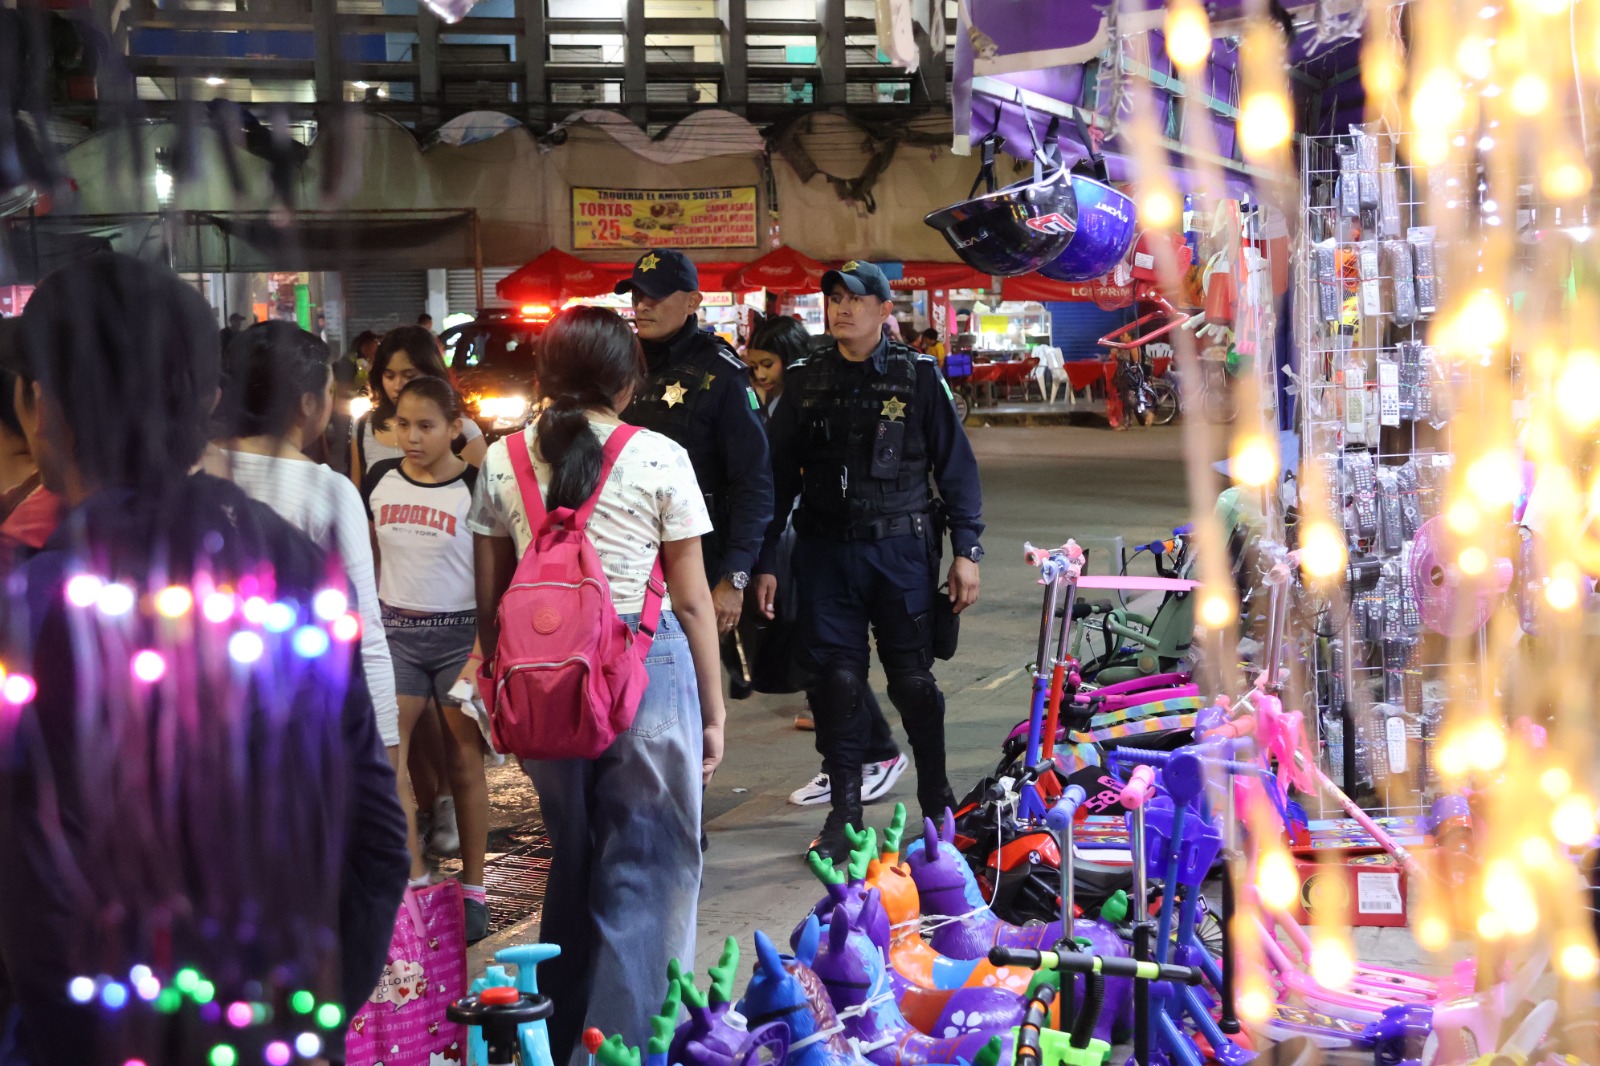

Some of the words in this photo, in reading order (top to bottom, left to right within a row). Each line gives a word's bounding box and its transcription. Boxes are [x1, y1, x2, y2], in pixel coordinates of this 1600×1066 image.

[579, 202, 633, 217] TORTAS
[379, 503, 457, 537] BROOKLYN
[414, 529, 438, 538] YORK
[378, 976, 402, 987] ELLO
